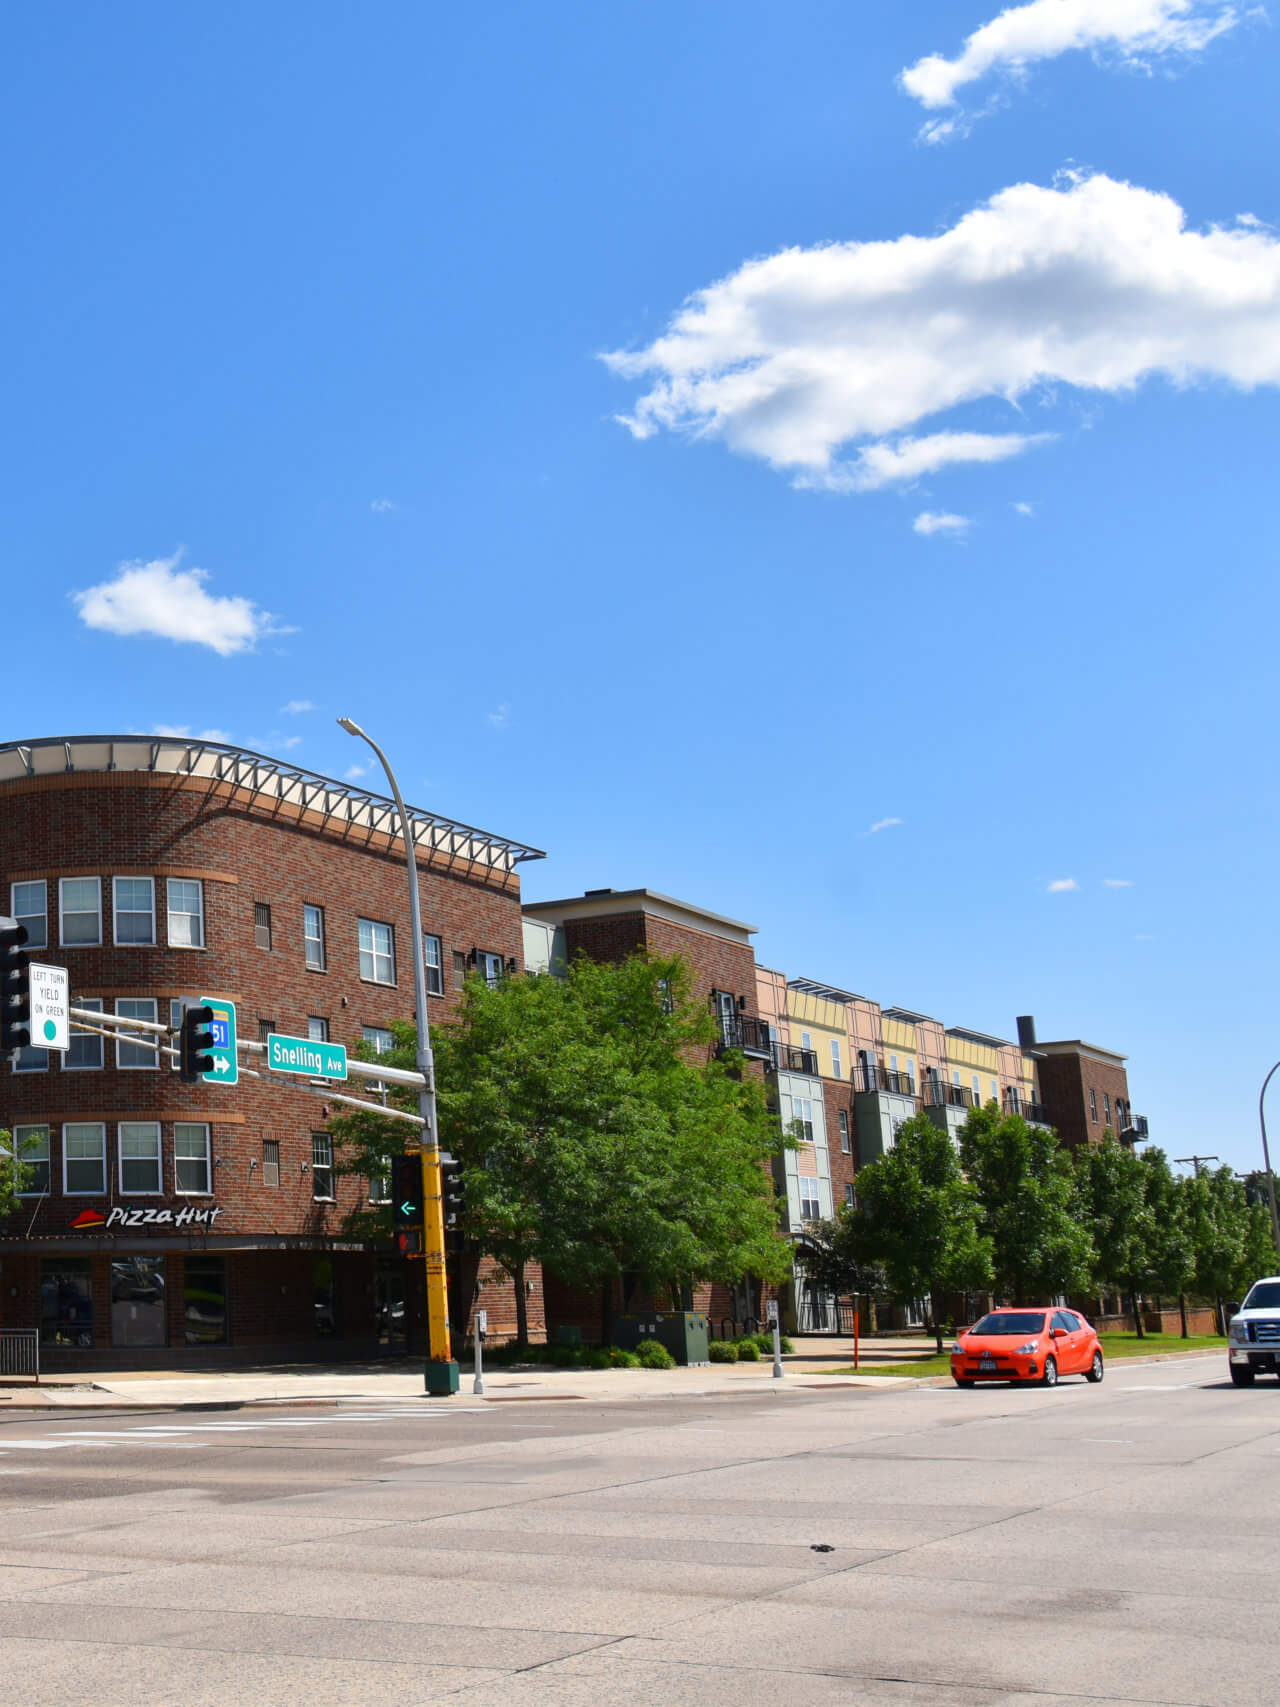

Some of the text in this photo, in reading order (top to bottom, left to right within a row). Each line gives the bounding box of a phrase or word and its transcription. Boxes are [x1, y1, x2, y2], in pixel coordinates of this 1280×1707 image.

[33, 971, 65, 985] LEFT TURN
[40, 987, 59, 1001] YIELD
[34, 1003, 64, 1017] ON GREEN
[212, 1024, 225, 1043] 51
[273, 1042, 343, 1074] Snelling Ave
[106, 1205, 224, 1228] Pizza Hut
